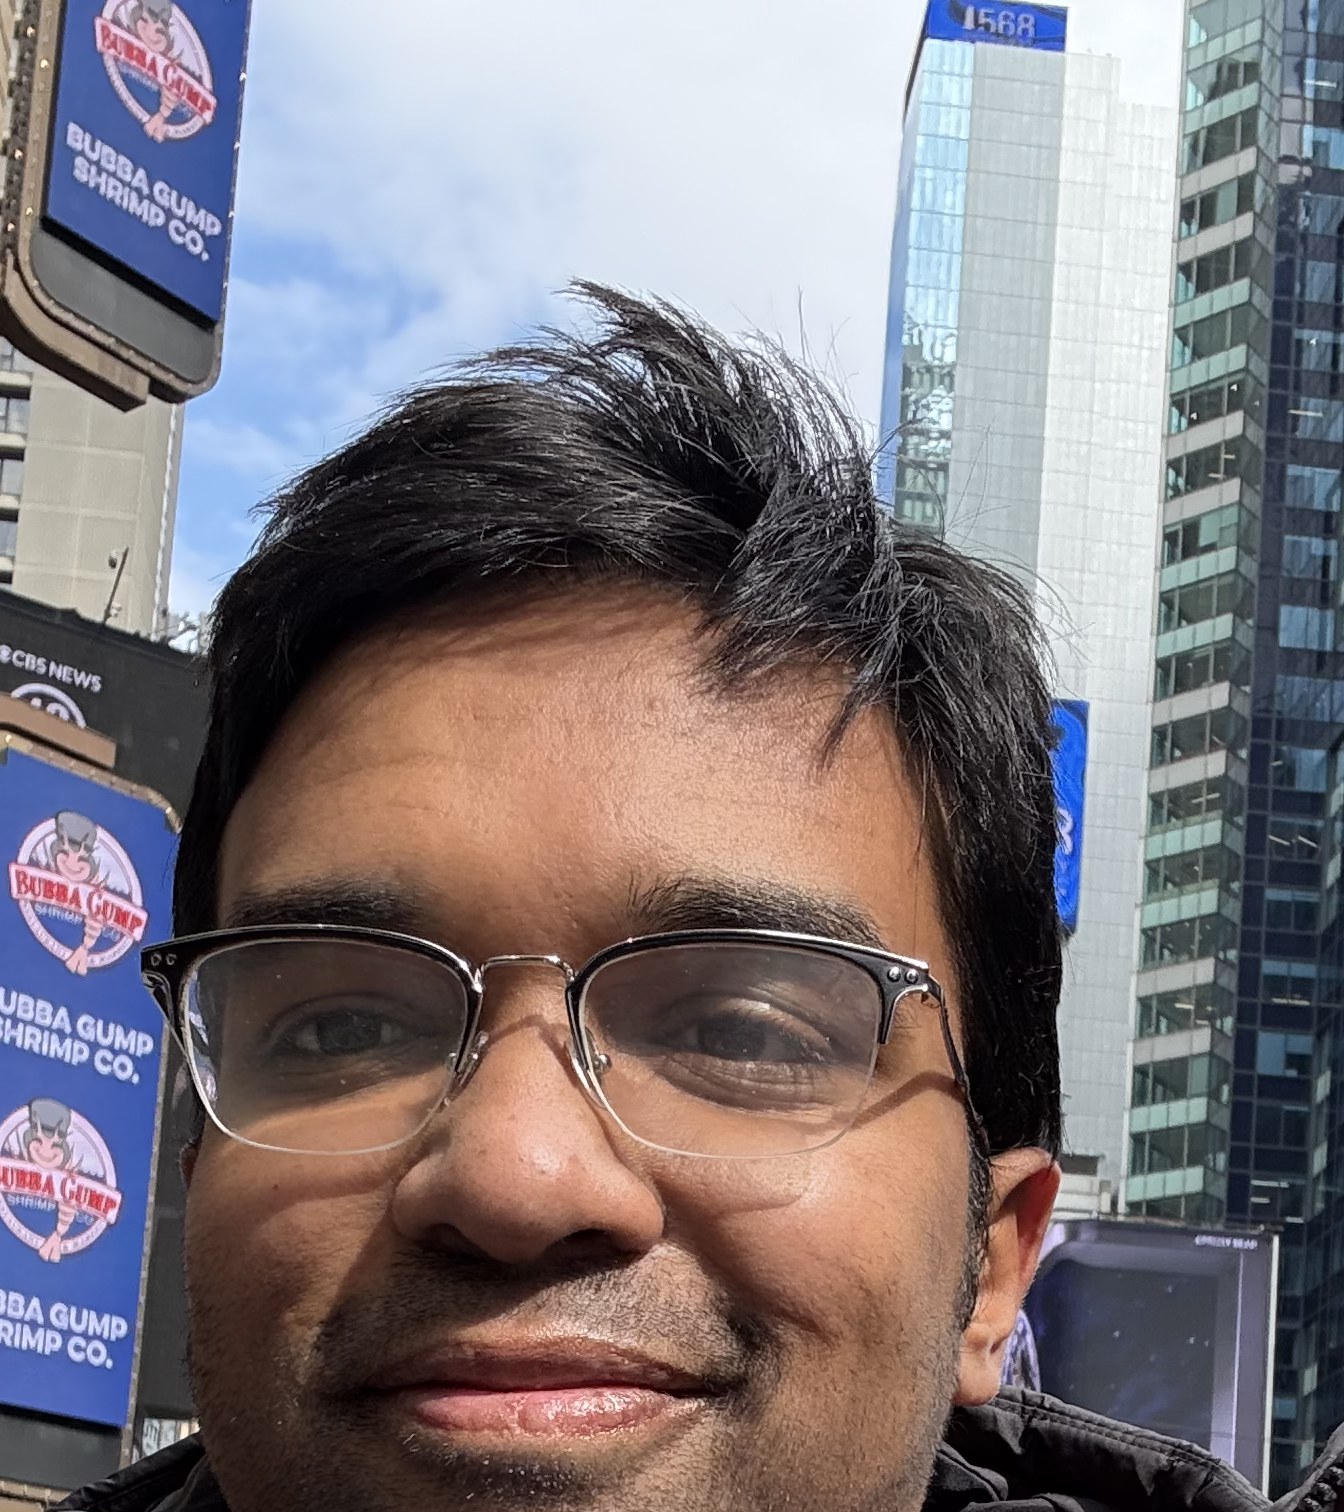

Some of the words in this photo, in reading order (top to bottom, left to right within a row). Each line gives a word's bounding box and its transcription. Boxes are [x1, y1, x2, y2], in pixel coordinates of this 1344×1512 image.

[100, 23, 158, 78] BUBBA
[162, 63, 213, 114] GUMP
[66, 121, 149, 196] BUBBA
[153, 181, 222, 238] GUMP
[73, 161, 165, 228] SHRIMP
[169, 218, 210, 262] CO.
[11, 650, 47, 675] CBS
[48, 661, 103, 693] NEWS
[15, 869, 81, 909] BUBBA
[86, 888, 145, 934] GUMP
[75, 1012, 154, 1057] GUMP
[93, 1048, 140, 1086] CO.
[60, 1177, 118, 1216] GUMP
[48, 1302, 130, 1342] GUMP
[65, 1335, 115, 1371] CO.
